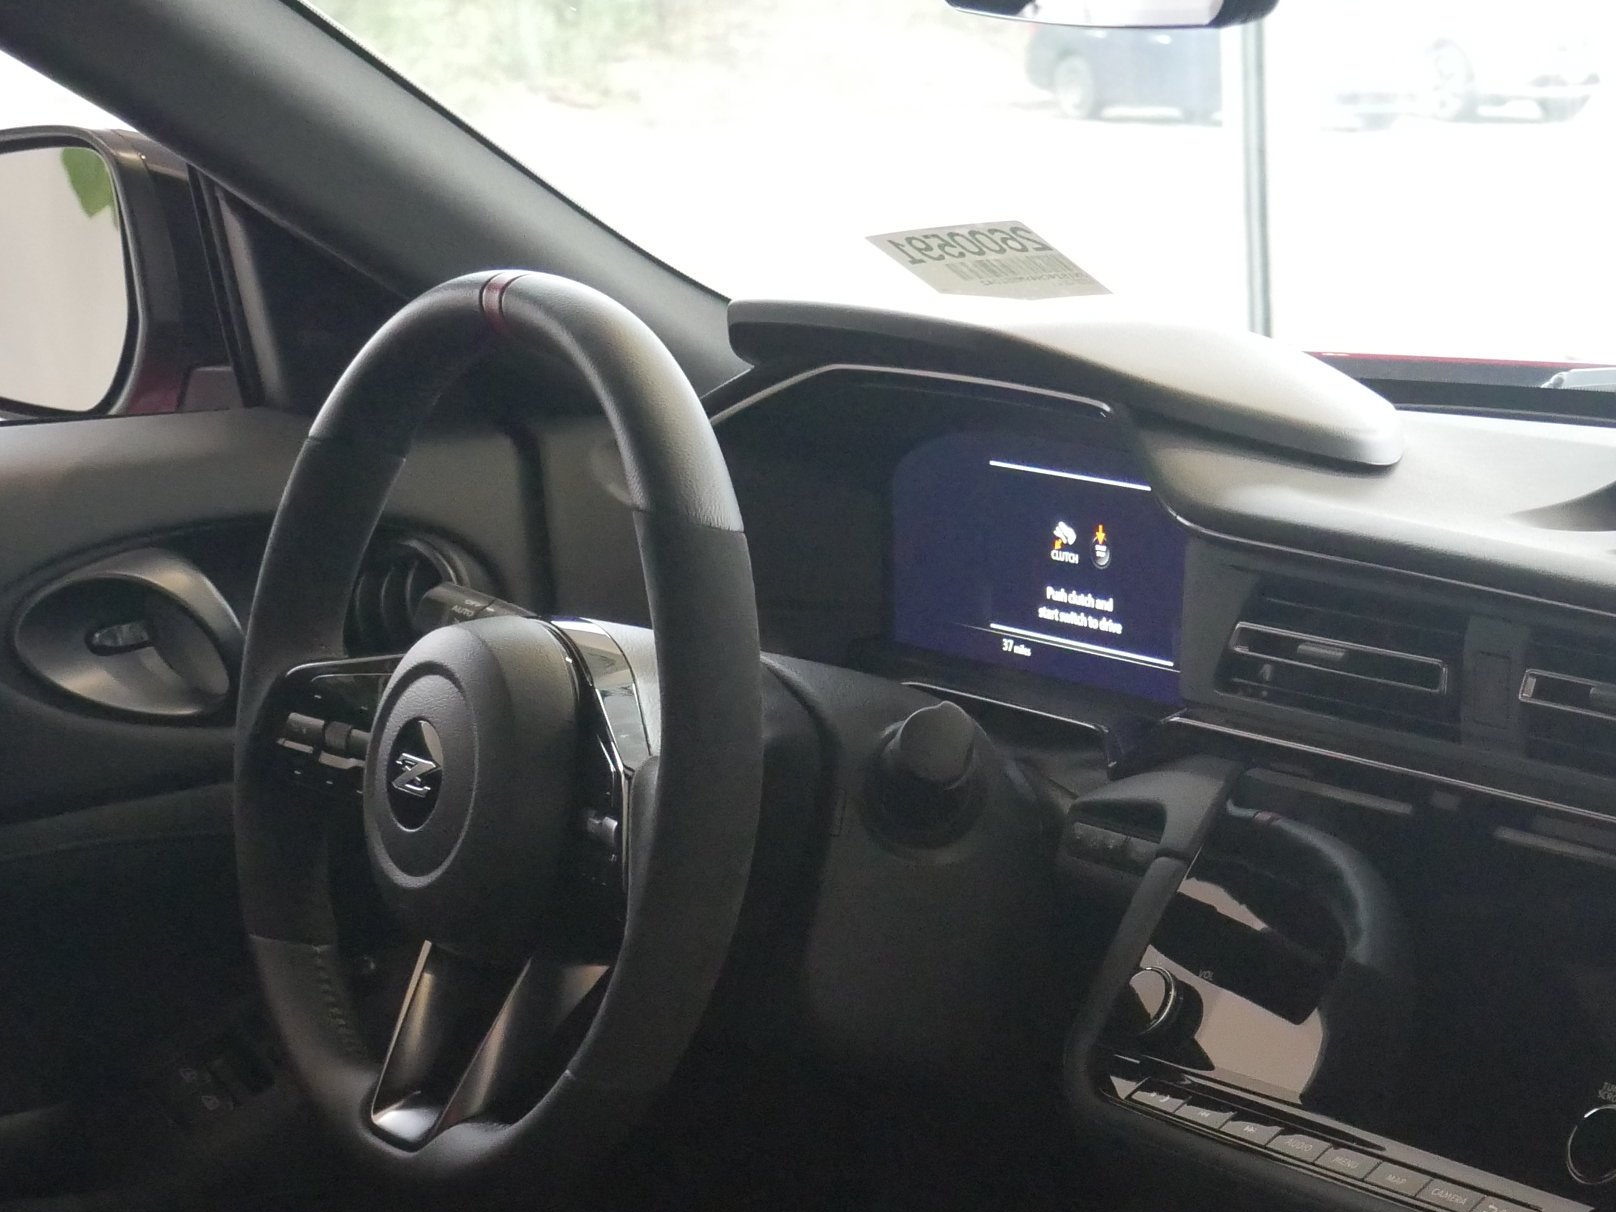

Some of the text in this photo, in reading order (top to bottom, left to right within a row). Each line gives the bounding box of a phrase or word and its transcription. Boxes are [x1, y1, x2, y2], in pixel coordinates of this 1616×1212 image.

[1050, 549, 1079, 564] CLUTCH
[1068, 590, 1095, 608] clutch
[1095, 597, 1114, 612] and
[451, 605, 474, 617] AUTO
[1038, 606, 1123, 634] start switch to drive
[1002, 638, 1014, 651] 37
[1284, 1138, 1313, 1153] AUDIO
[1332, 1155, 1360, 1170] MENU
[1386, 1174, 1408, 1186] MAP
[1431, 1187, 1468, 1206] CAMERA
